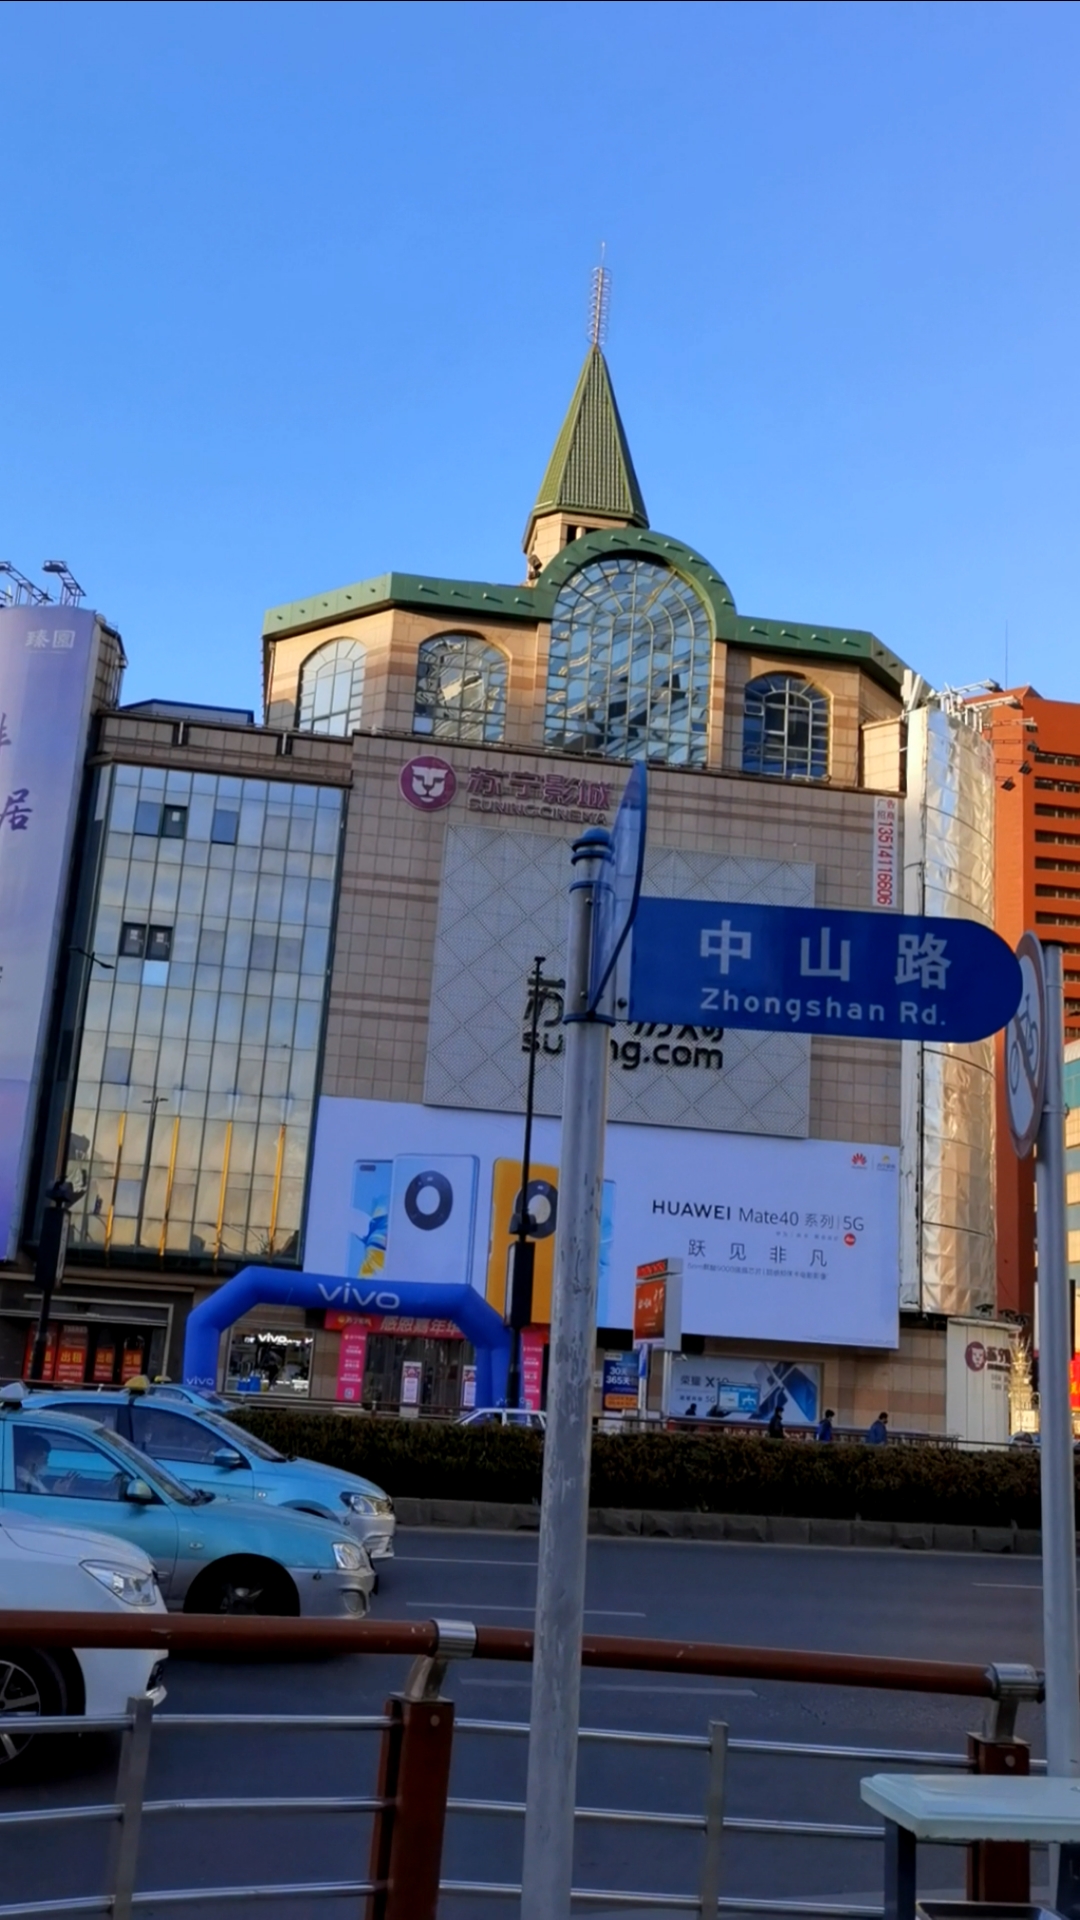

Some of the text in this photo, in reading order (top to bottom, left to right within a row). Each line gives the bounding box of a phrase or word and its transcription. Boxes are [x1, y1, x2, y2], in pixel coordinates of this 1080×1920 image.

[467, 767, 611, 810] 苏宁影城
[700, 919, 951, 990] 中山路
[701, 988, 947, 1026] Zhongshan Rd.
[652, 1200, 864, 1231] HUAWEI Mate40 系列 5G
[687, 1239, 828, 1268] 跃见非凡
[318, 1283, 400, 1309] vivo
[258, 1332, 288, 1344] vivo
[186, 1376, 215, 1386] vivo
